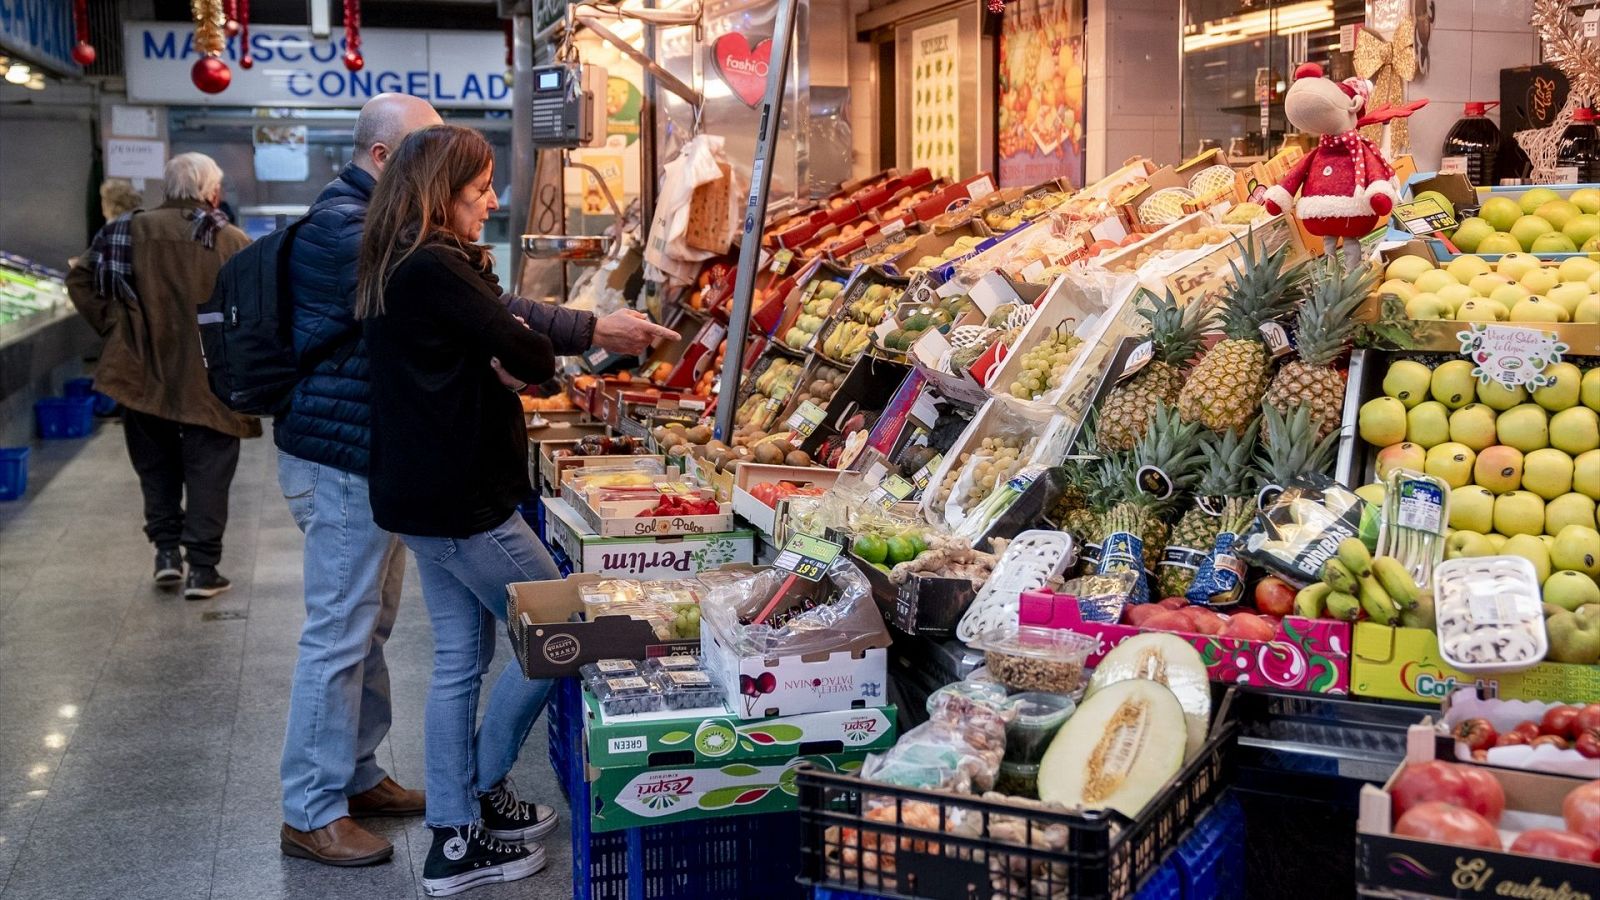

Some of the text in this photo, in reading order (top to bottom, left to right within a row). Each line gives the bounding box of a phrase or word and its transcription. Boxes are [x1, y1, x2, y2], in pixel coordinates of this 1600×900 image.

[1515, 331, 1538, 344] Sabor
[635, 518, 704, 535] Sol Palos
[602, 550, 692, 574] Perlim
[547, 640, 572, 651] QUALITY
[550, 646, 576, 658] BRAND
[822, 684, 853, 694] SWEET
[841, 719, 877, 732] Zespri
[614, 739, 642, 750] GREEN
[637, 776, 694, 798] Zespri
[1452, 855, 1494, 892] El
